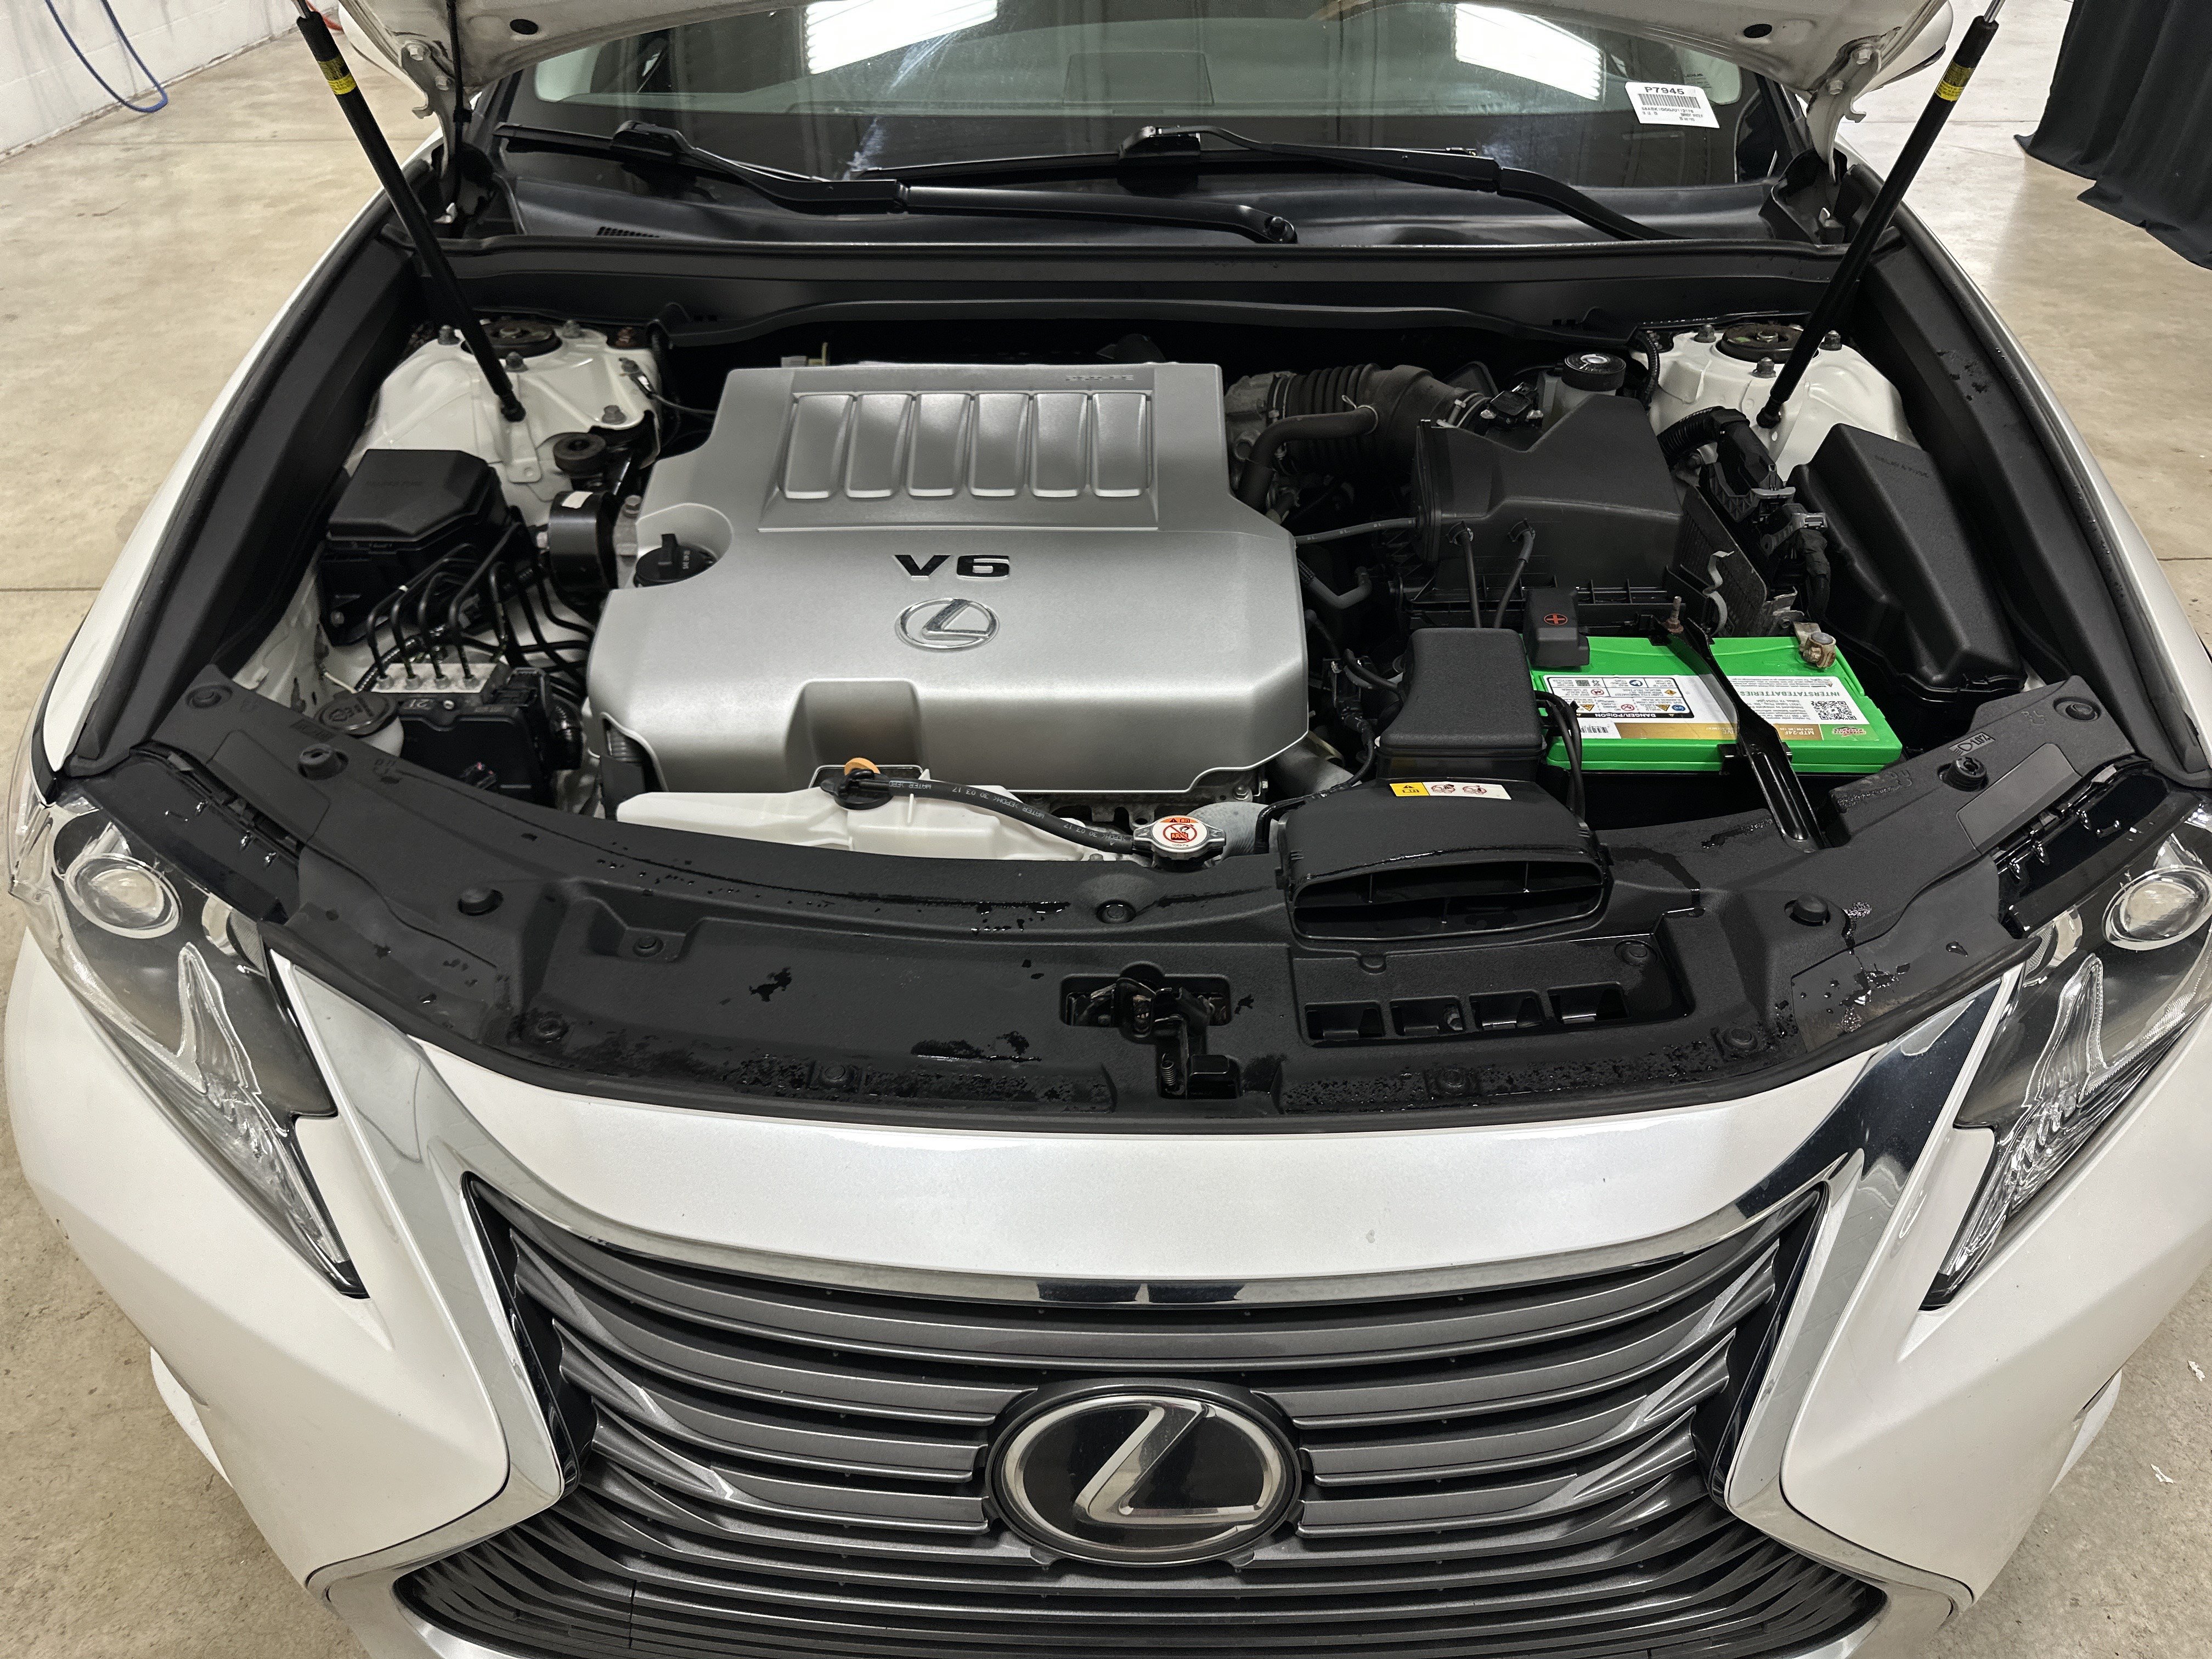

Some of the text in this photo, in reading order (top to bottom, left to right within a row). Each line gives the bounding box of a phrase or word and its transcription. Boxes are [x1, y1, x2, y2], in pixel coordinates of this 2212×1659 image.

[1644, 87, 1685, 95] P7945
[894, 554, 1011, 580] V6
[1022, 805, 1045, 819] WATER
